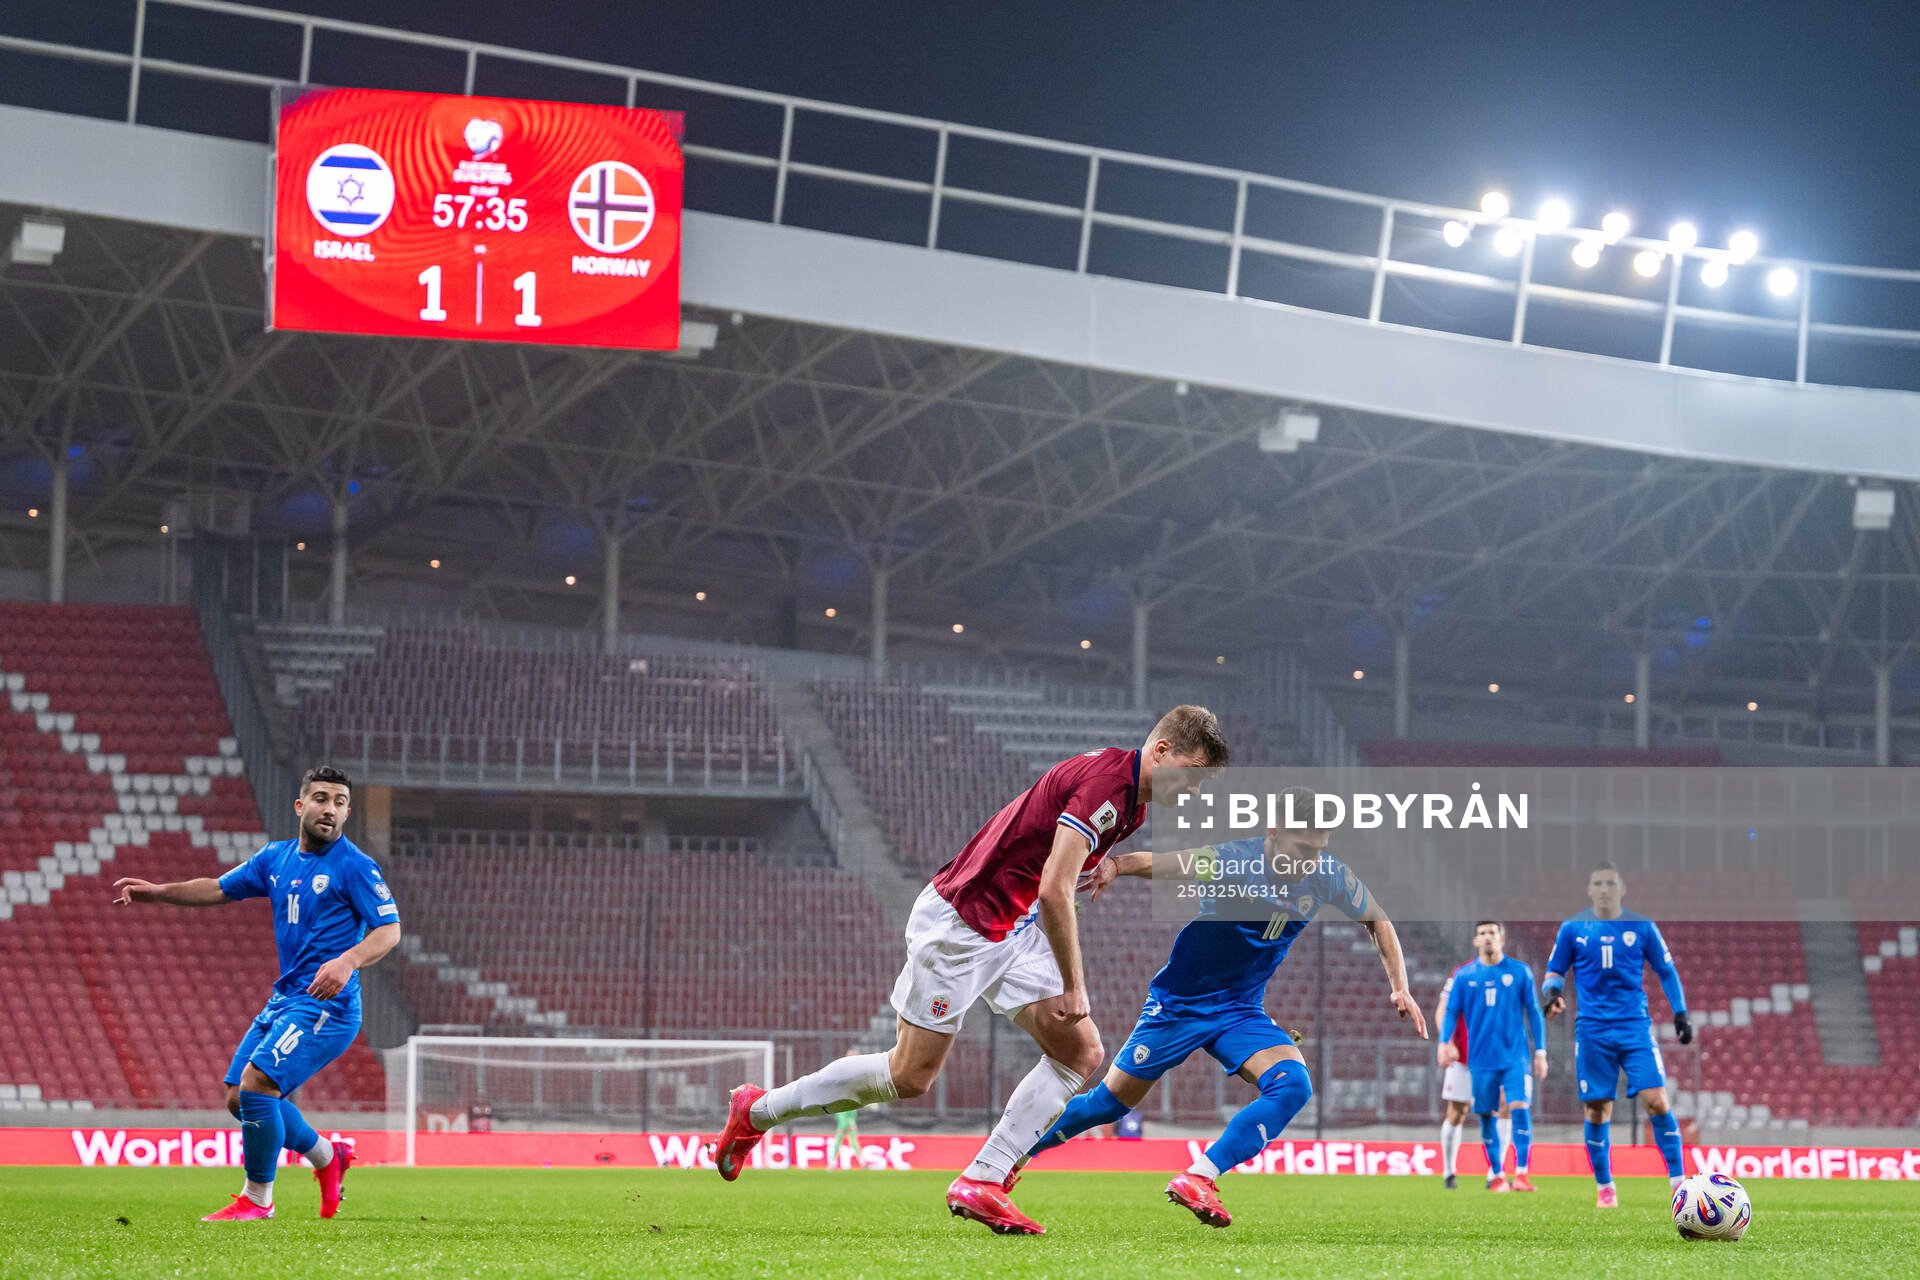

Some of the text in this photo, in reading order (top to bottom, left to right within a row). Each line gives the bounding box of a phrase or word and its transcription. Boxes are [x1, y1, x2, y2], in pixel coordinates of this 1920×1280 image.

[433, 193, 528, 232] 57:35
[314, 240, 375, 262] ISRAEL
[571, 256, 652, 278] NORWAY
[418, 265, 542, 328] 1 1
[287, 893, 300, 924] 16
[1262, 911, 1289, 941] 10
[274, 1022, 304, 1056] 16
[71, 1130, 356, 1167] WorldF
[648, 1135, 915, 1170] WldFirst
